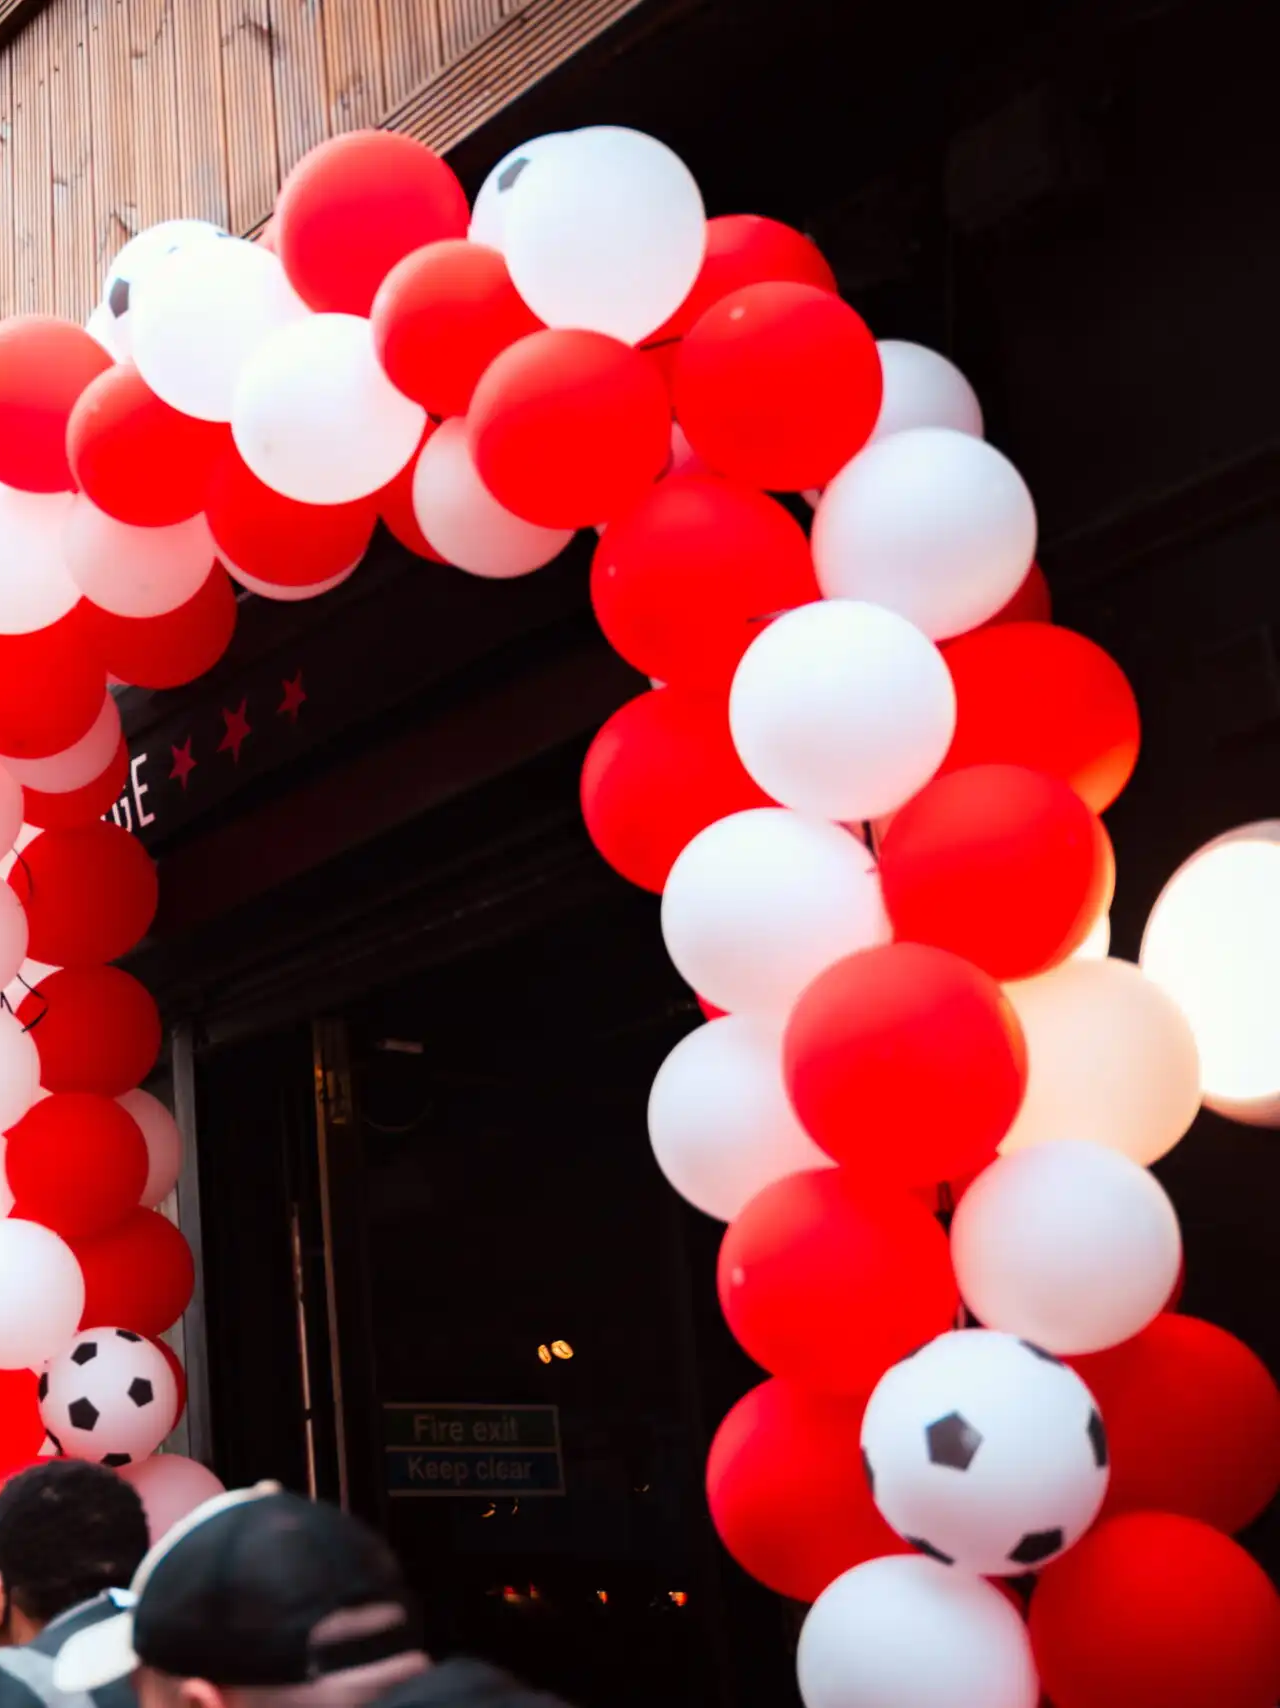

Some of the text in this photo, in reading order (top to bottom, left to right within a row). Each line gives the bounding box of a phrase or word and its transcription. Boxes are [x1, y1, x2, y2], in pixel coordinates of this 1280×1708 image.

[414, 1414, 518, 1442] Fire exit
[407, 1454, 533, 1486] Keep clear
